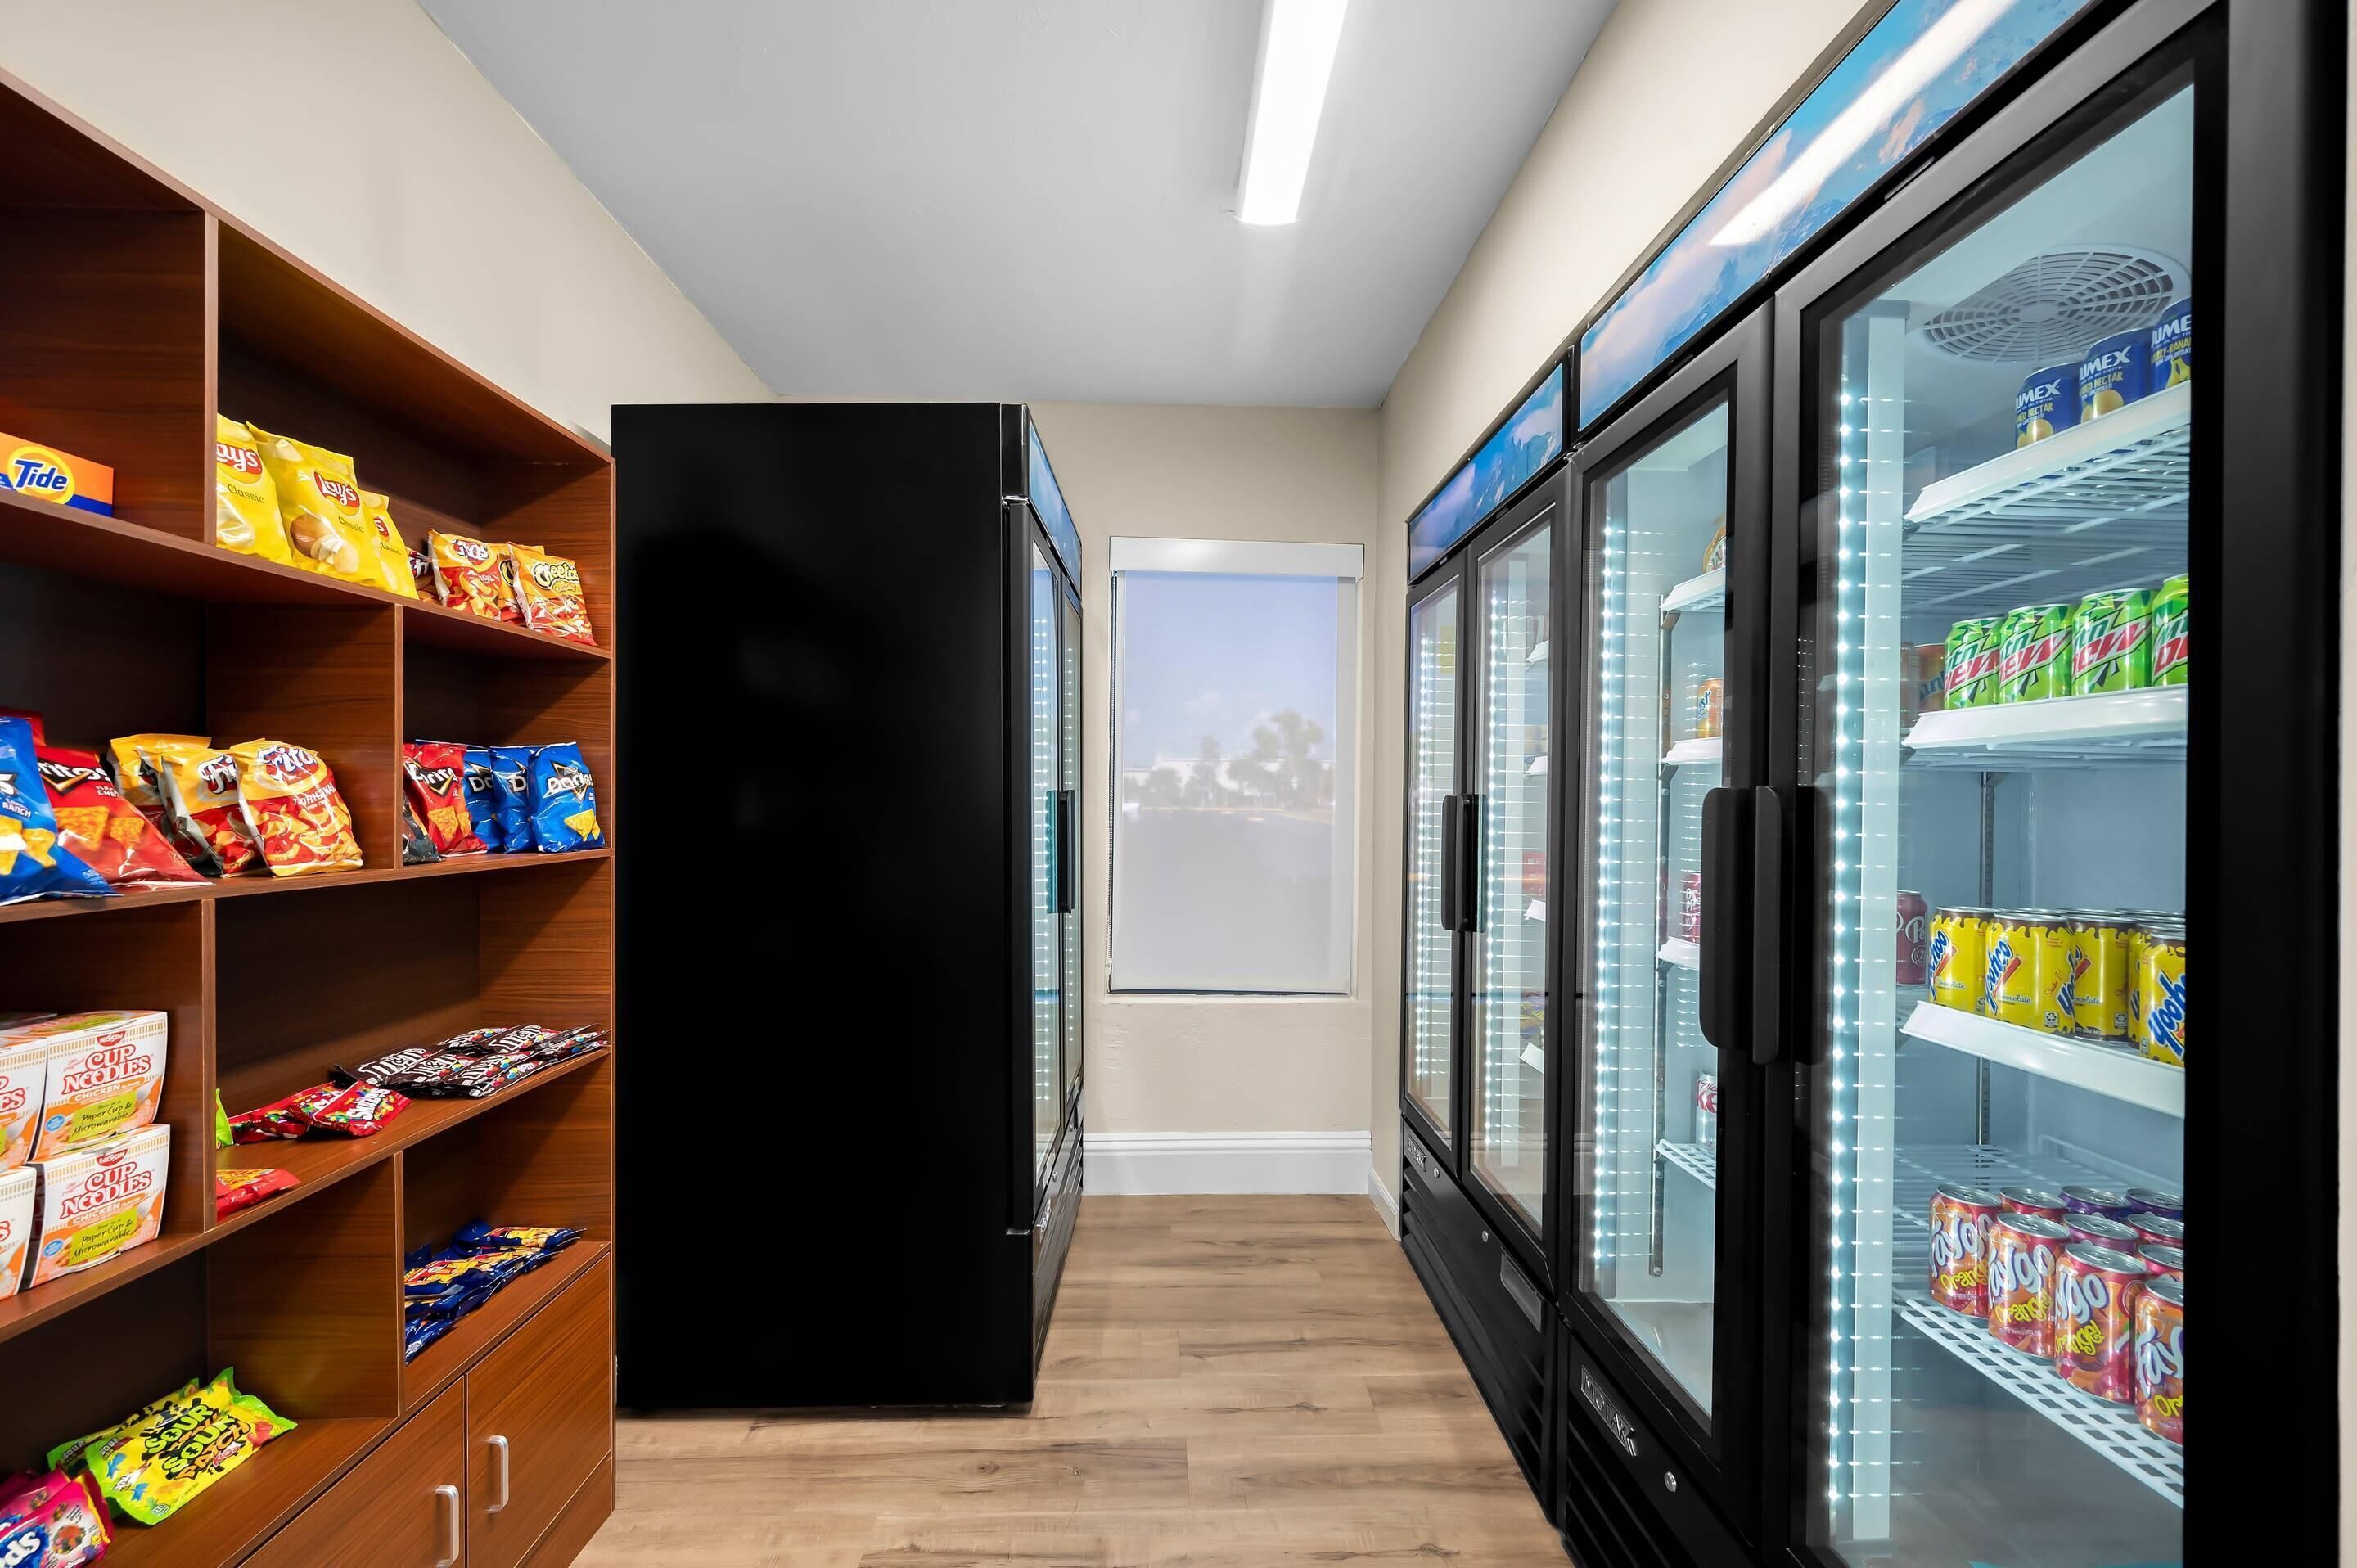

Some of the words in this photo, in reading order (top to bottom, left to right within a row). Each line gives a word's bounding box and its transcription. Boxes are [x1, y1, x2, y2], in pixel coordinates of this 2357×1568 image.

[2093, 371, 2123, 389] NECTAR
[2016, 379, 2062, 410] UMEX
[2027, 403, 2054, 418] NECTAR
[15, 459, 68, 490] Tide
[228, 484, 265, 503] Classic
[534, 561, 580, 588] Cheeto
[85, 1044, 137, 1070] CUP
[61, 1055, 151, 1095] NOODLES
[74, 1084, 121, 1102] CHICKEN
[71, 1111, 128, 1137] Microwavable
[81, 1110, 106, 1124] Paper
[107, 1105, 124, 1116] Cup
[124, 1102, 133, 1110] &
[85, 1161, 137, 1192] CUP
[60, 1171, 151, 1219] NOODLES
[72, 1201, 121, 1224] CHICKEN
[71, 1230, 131, 1259] Microwavable
[81, 1231, 106, 1246] Paper
[107, 1223, 124, 1236] Cup
[124, 1219, 133, 1228] &
[146, 1404, 214, 1454] SOUR
[63, 1440, 87, 1460] SOUR
[163, 1414, 236, 1473] SOUR
[175, 1420, 250, 1480] PATCH
